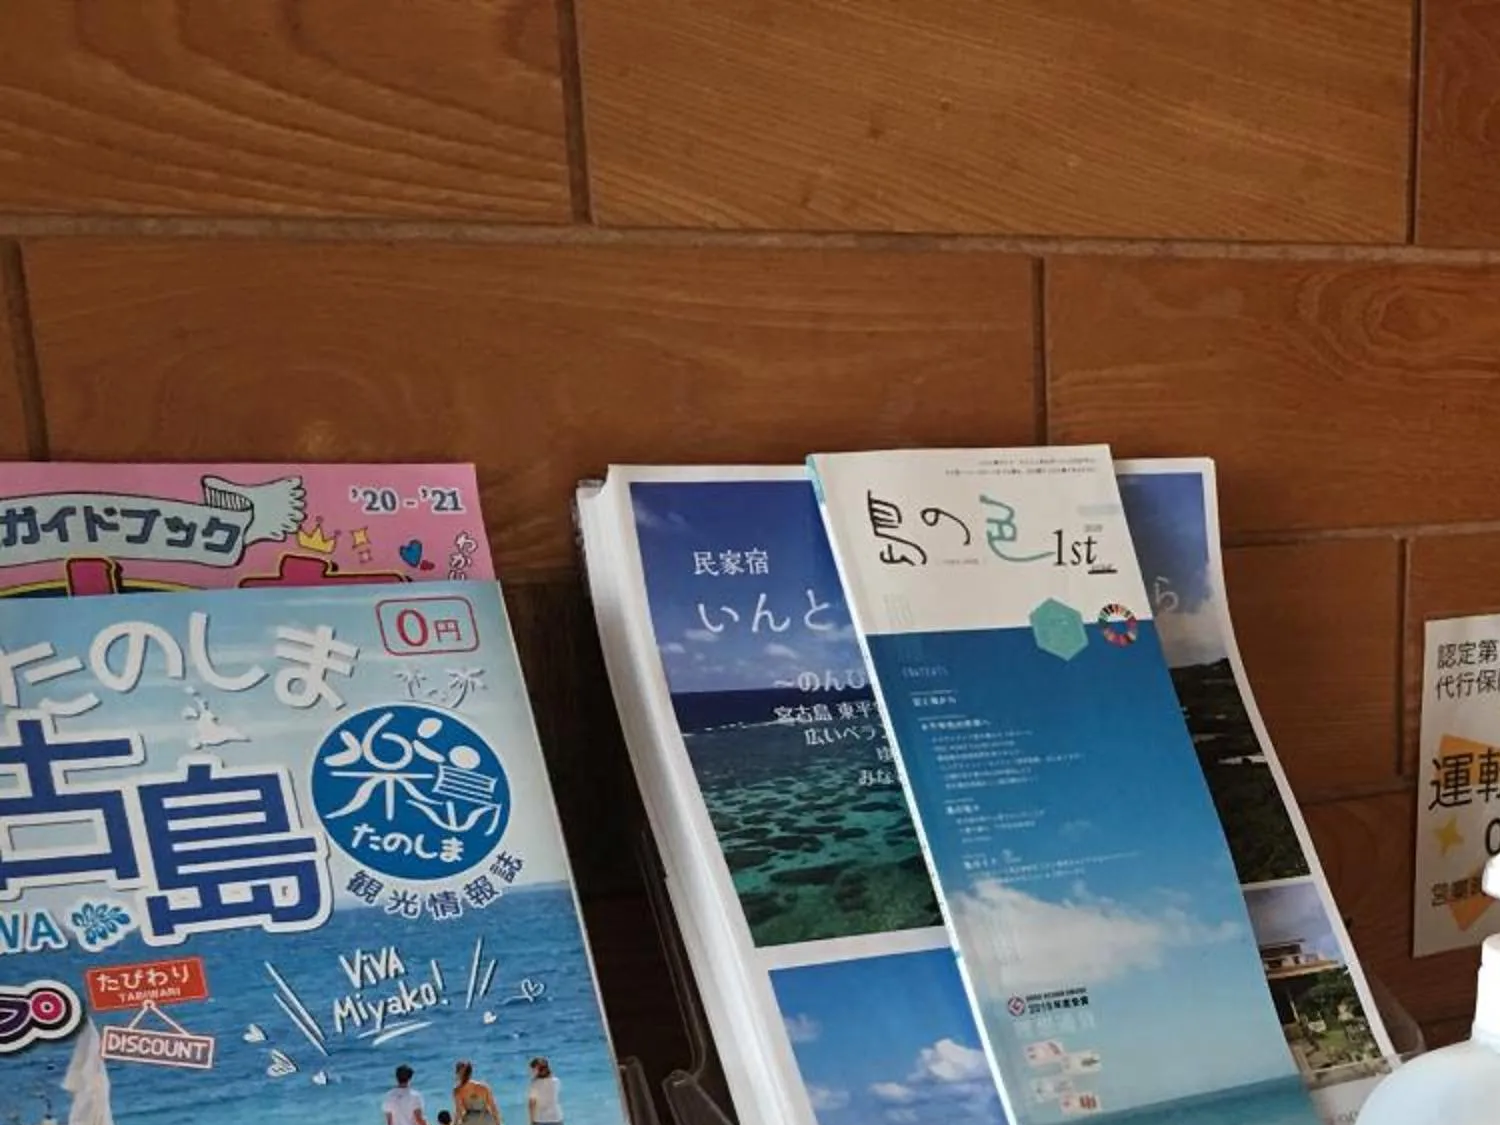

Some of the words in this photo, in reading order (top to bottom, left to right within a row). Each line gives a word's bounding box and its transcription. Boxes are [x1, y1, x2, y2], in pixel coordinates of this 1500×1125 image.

[0, 506, 242, 555] ガイドブック
[1053, 528, 1099, 566] 1st
[693, 548, 770, 577] 民家宿
[394, 607, 462, 649] 0円
[697, 589, 835, 634] いんと
[804, 724, 887, 746] 広いベラ
[351, 822, 464, 863] たのしま
[346, 850, 524, 918] 観光情報誌
[95, 963, 190, 993] たびわり
[333, 958, 449, 1034] Miyako!
[107, 1032, 209, 1060] DISCOUNT
